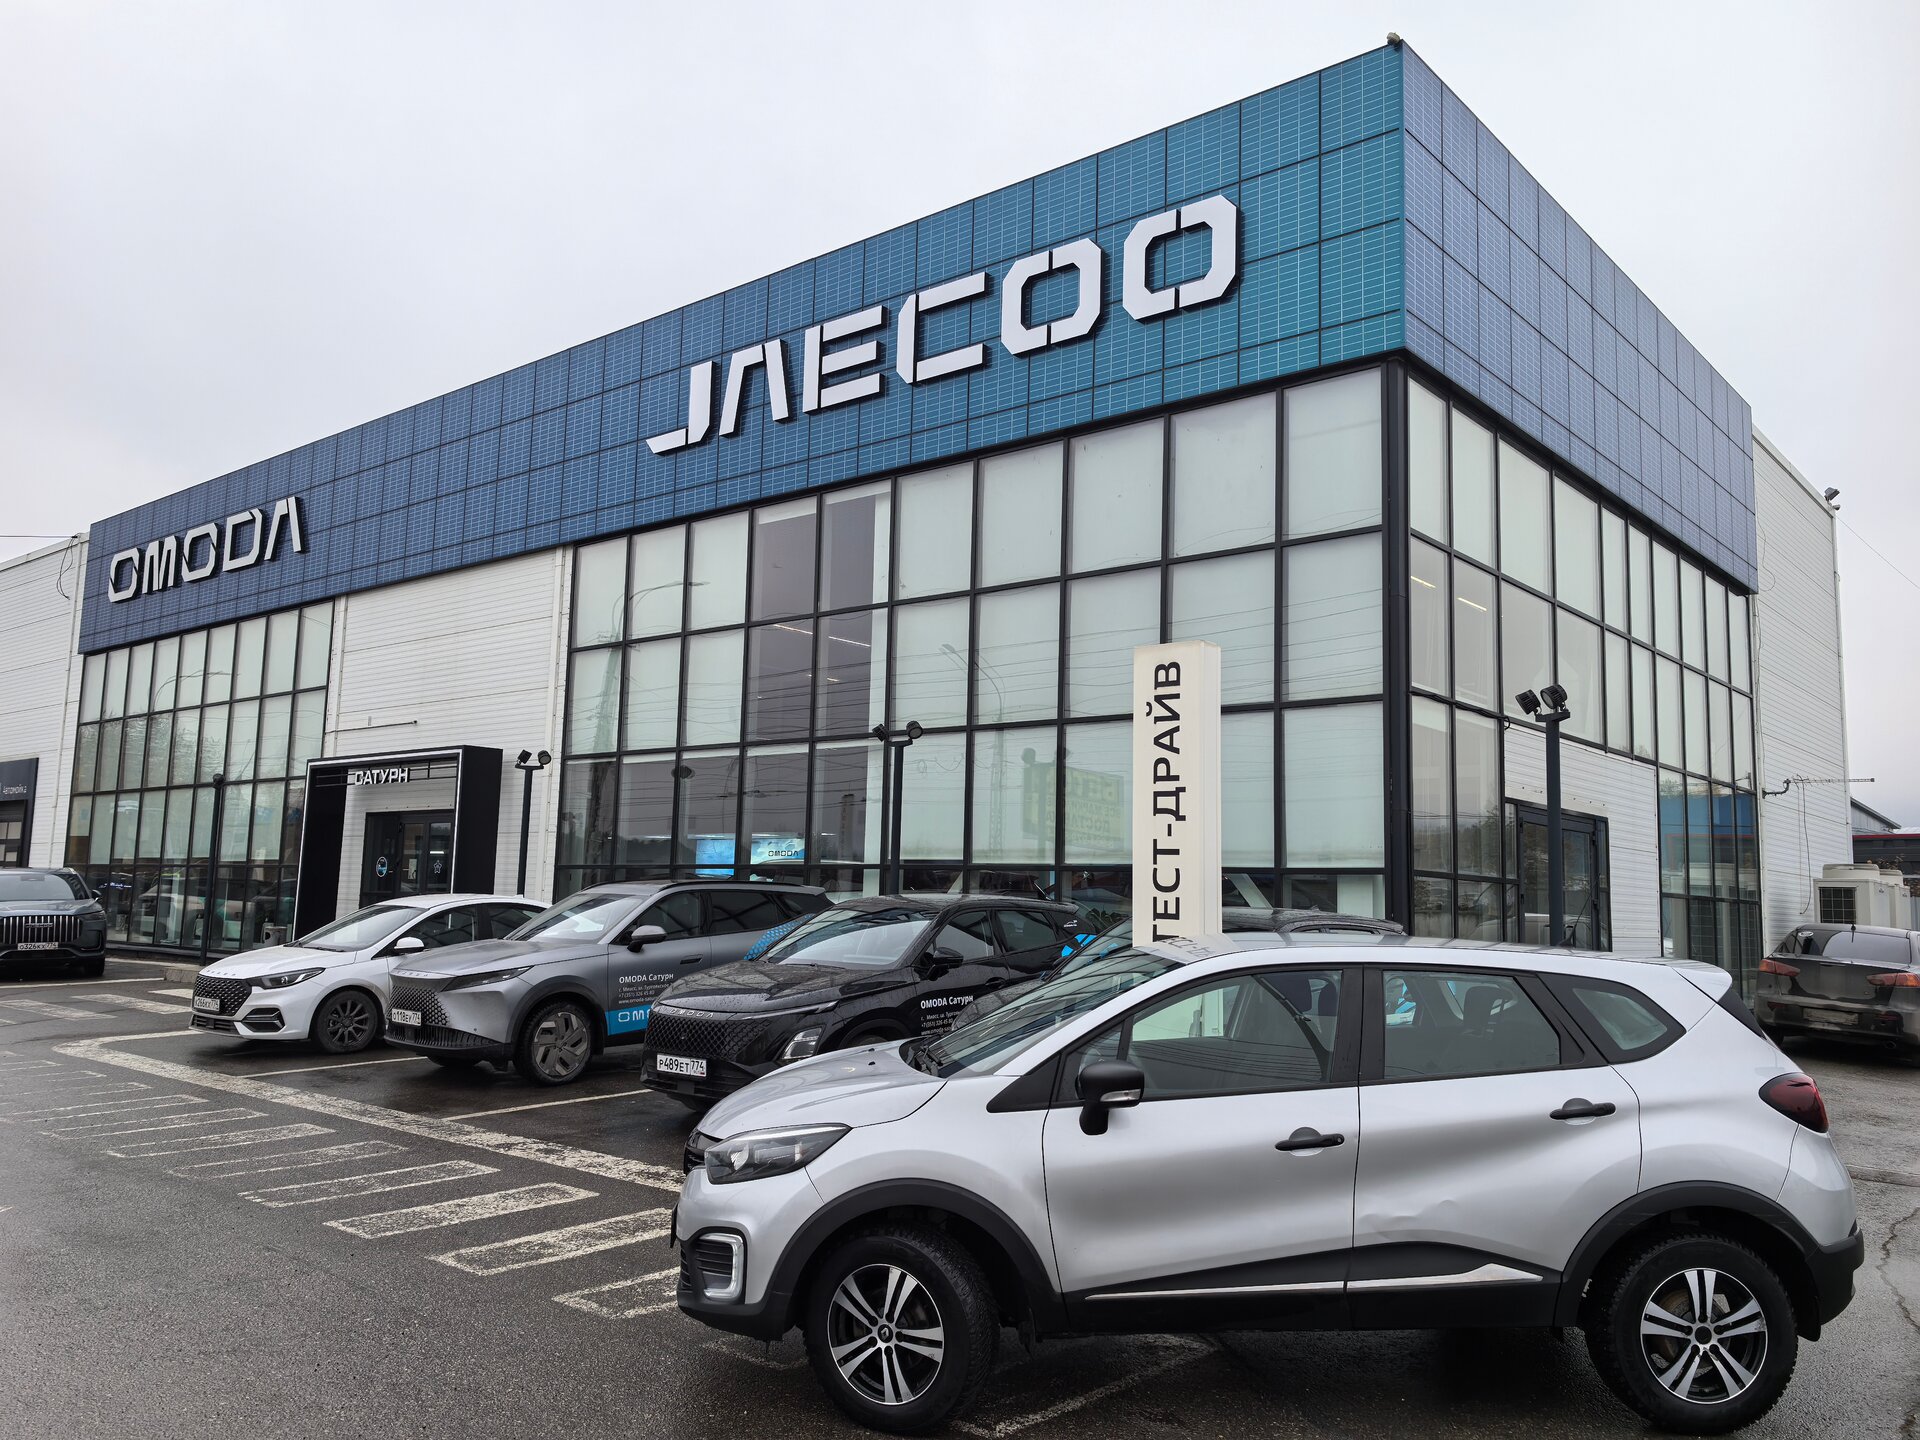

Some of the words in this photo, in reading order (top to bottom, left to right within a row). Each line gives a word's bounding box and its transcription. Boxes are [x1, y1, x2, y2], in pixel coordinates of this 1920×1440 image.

[646, 194, 1238, 455] JAECOO
[107, 495, 302, 603] OMODA
[355, 767, 409, 786] САТУРН
[1146, 661, 1186, 942] ТЕСТ-ДРАЙВ
[619, 974, 647, 984] OMODA
[648, 973, 674, 982] Сатурн
[920, 997, 947, 1009] OMODA
[948, 995, 973, 1006] Сатурн
